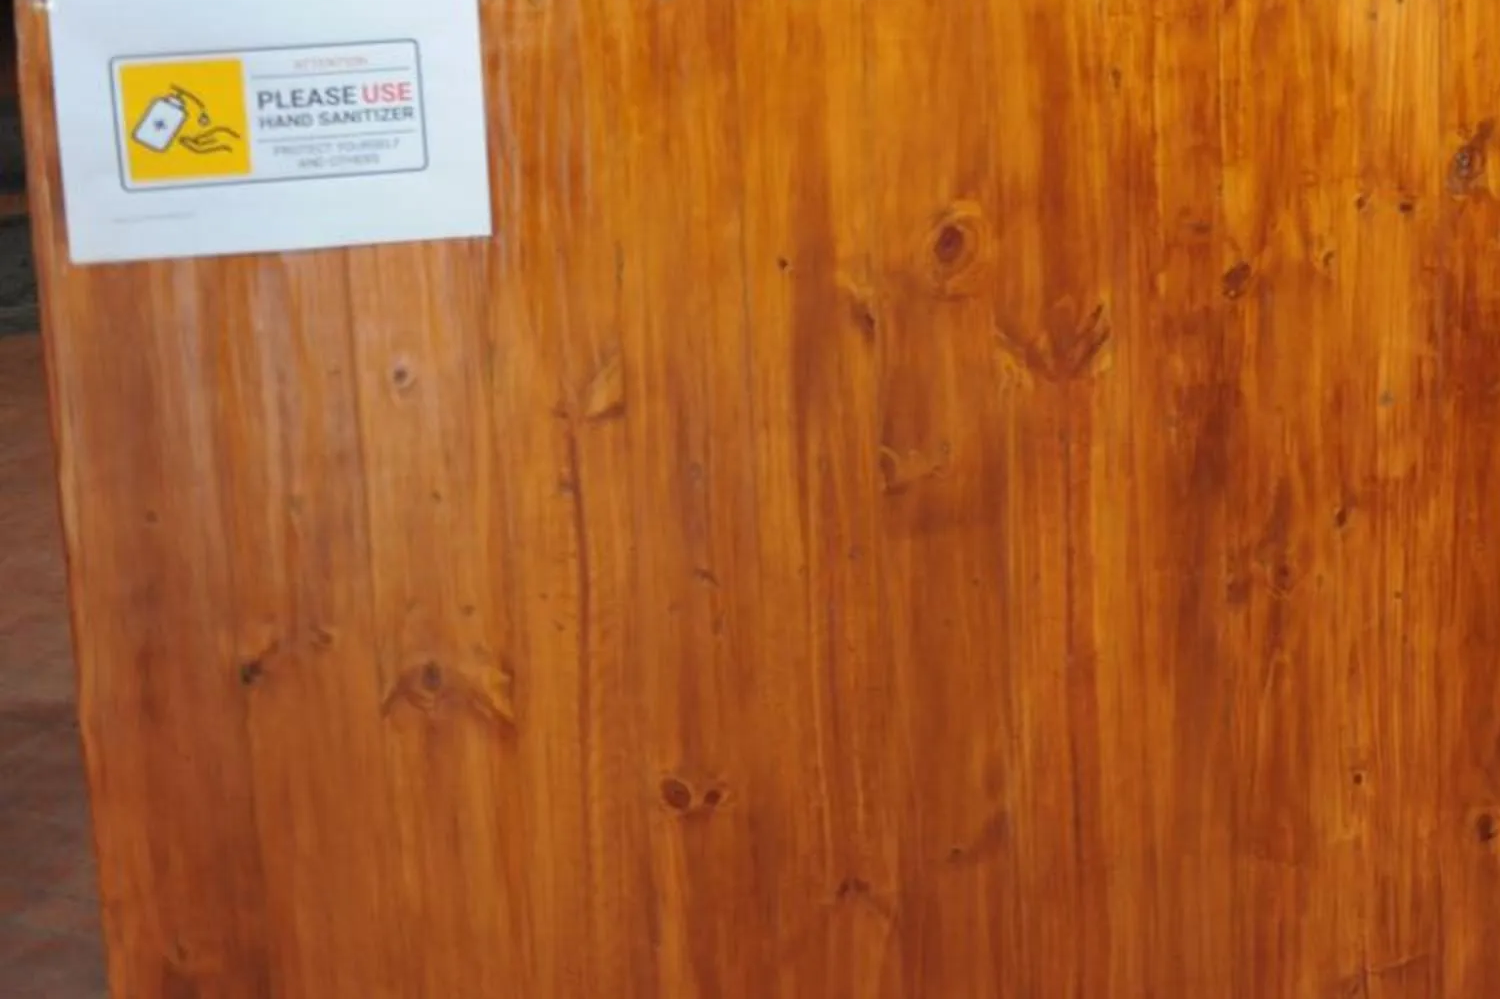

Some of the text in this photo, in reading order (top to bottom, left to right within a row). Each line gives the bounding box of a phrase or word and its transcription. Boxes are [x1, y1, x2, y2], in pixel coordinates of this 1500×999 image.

[257, 81, 413, 110] PLEASE USE
[258, 106, 414, 130] HAND SANITIZER
